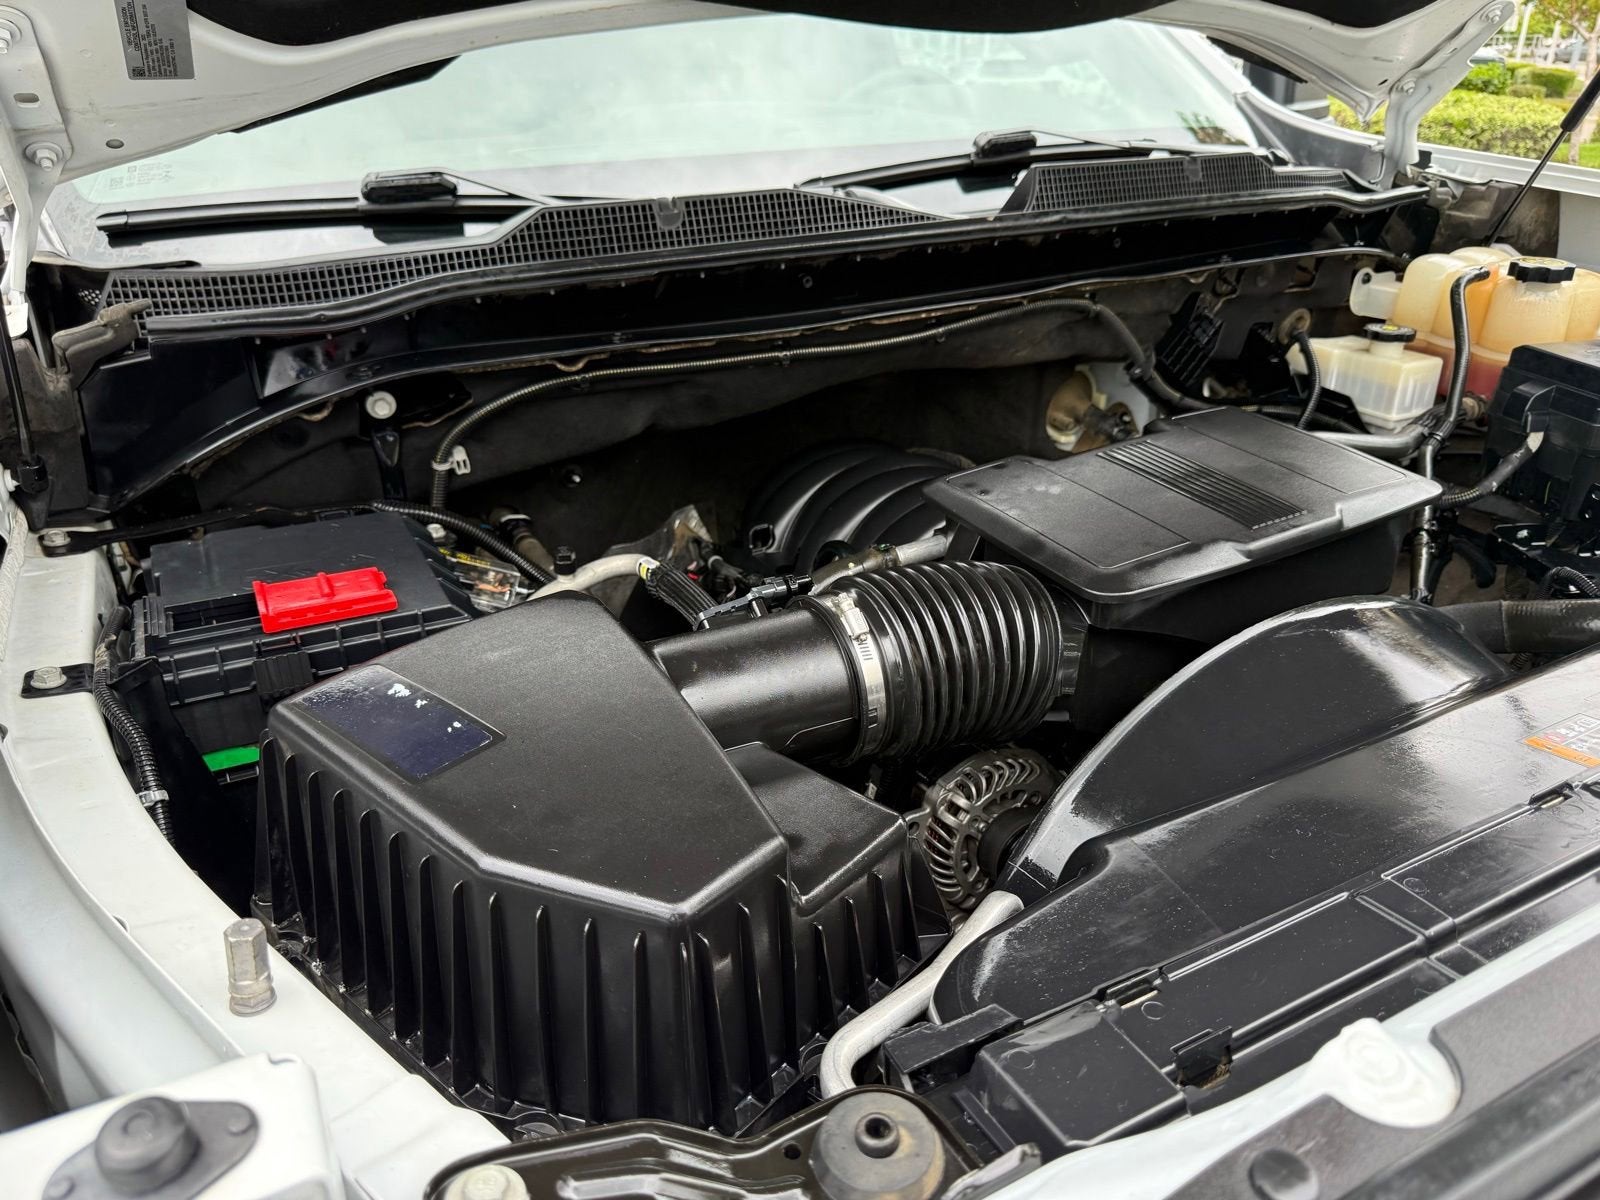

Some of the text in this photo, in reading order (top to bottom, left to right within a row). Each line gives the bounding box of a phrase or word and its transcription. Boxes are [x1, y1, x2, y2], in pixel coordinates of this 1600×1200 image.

[121, 7, 130, 27] EMISSION
[127, 2, 140, 52] CONTROL INFORMATION
